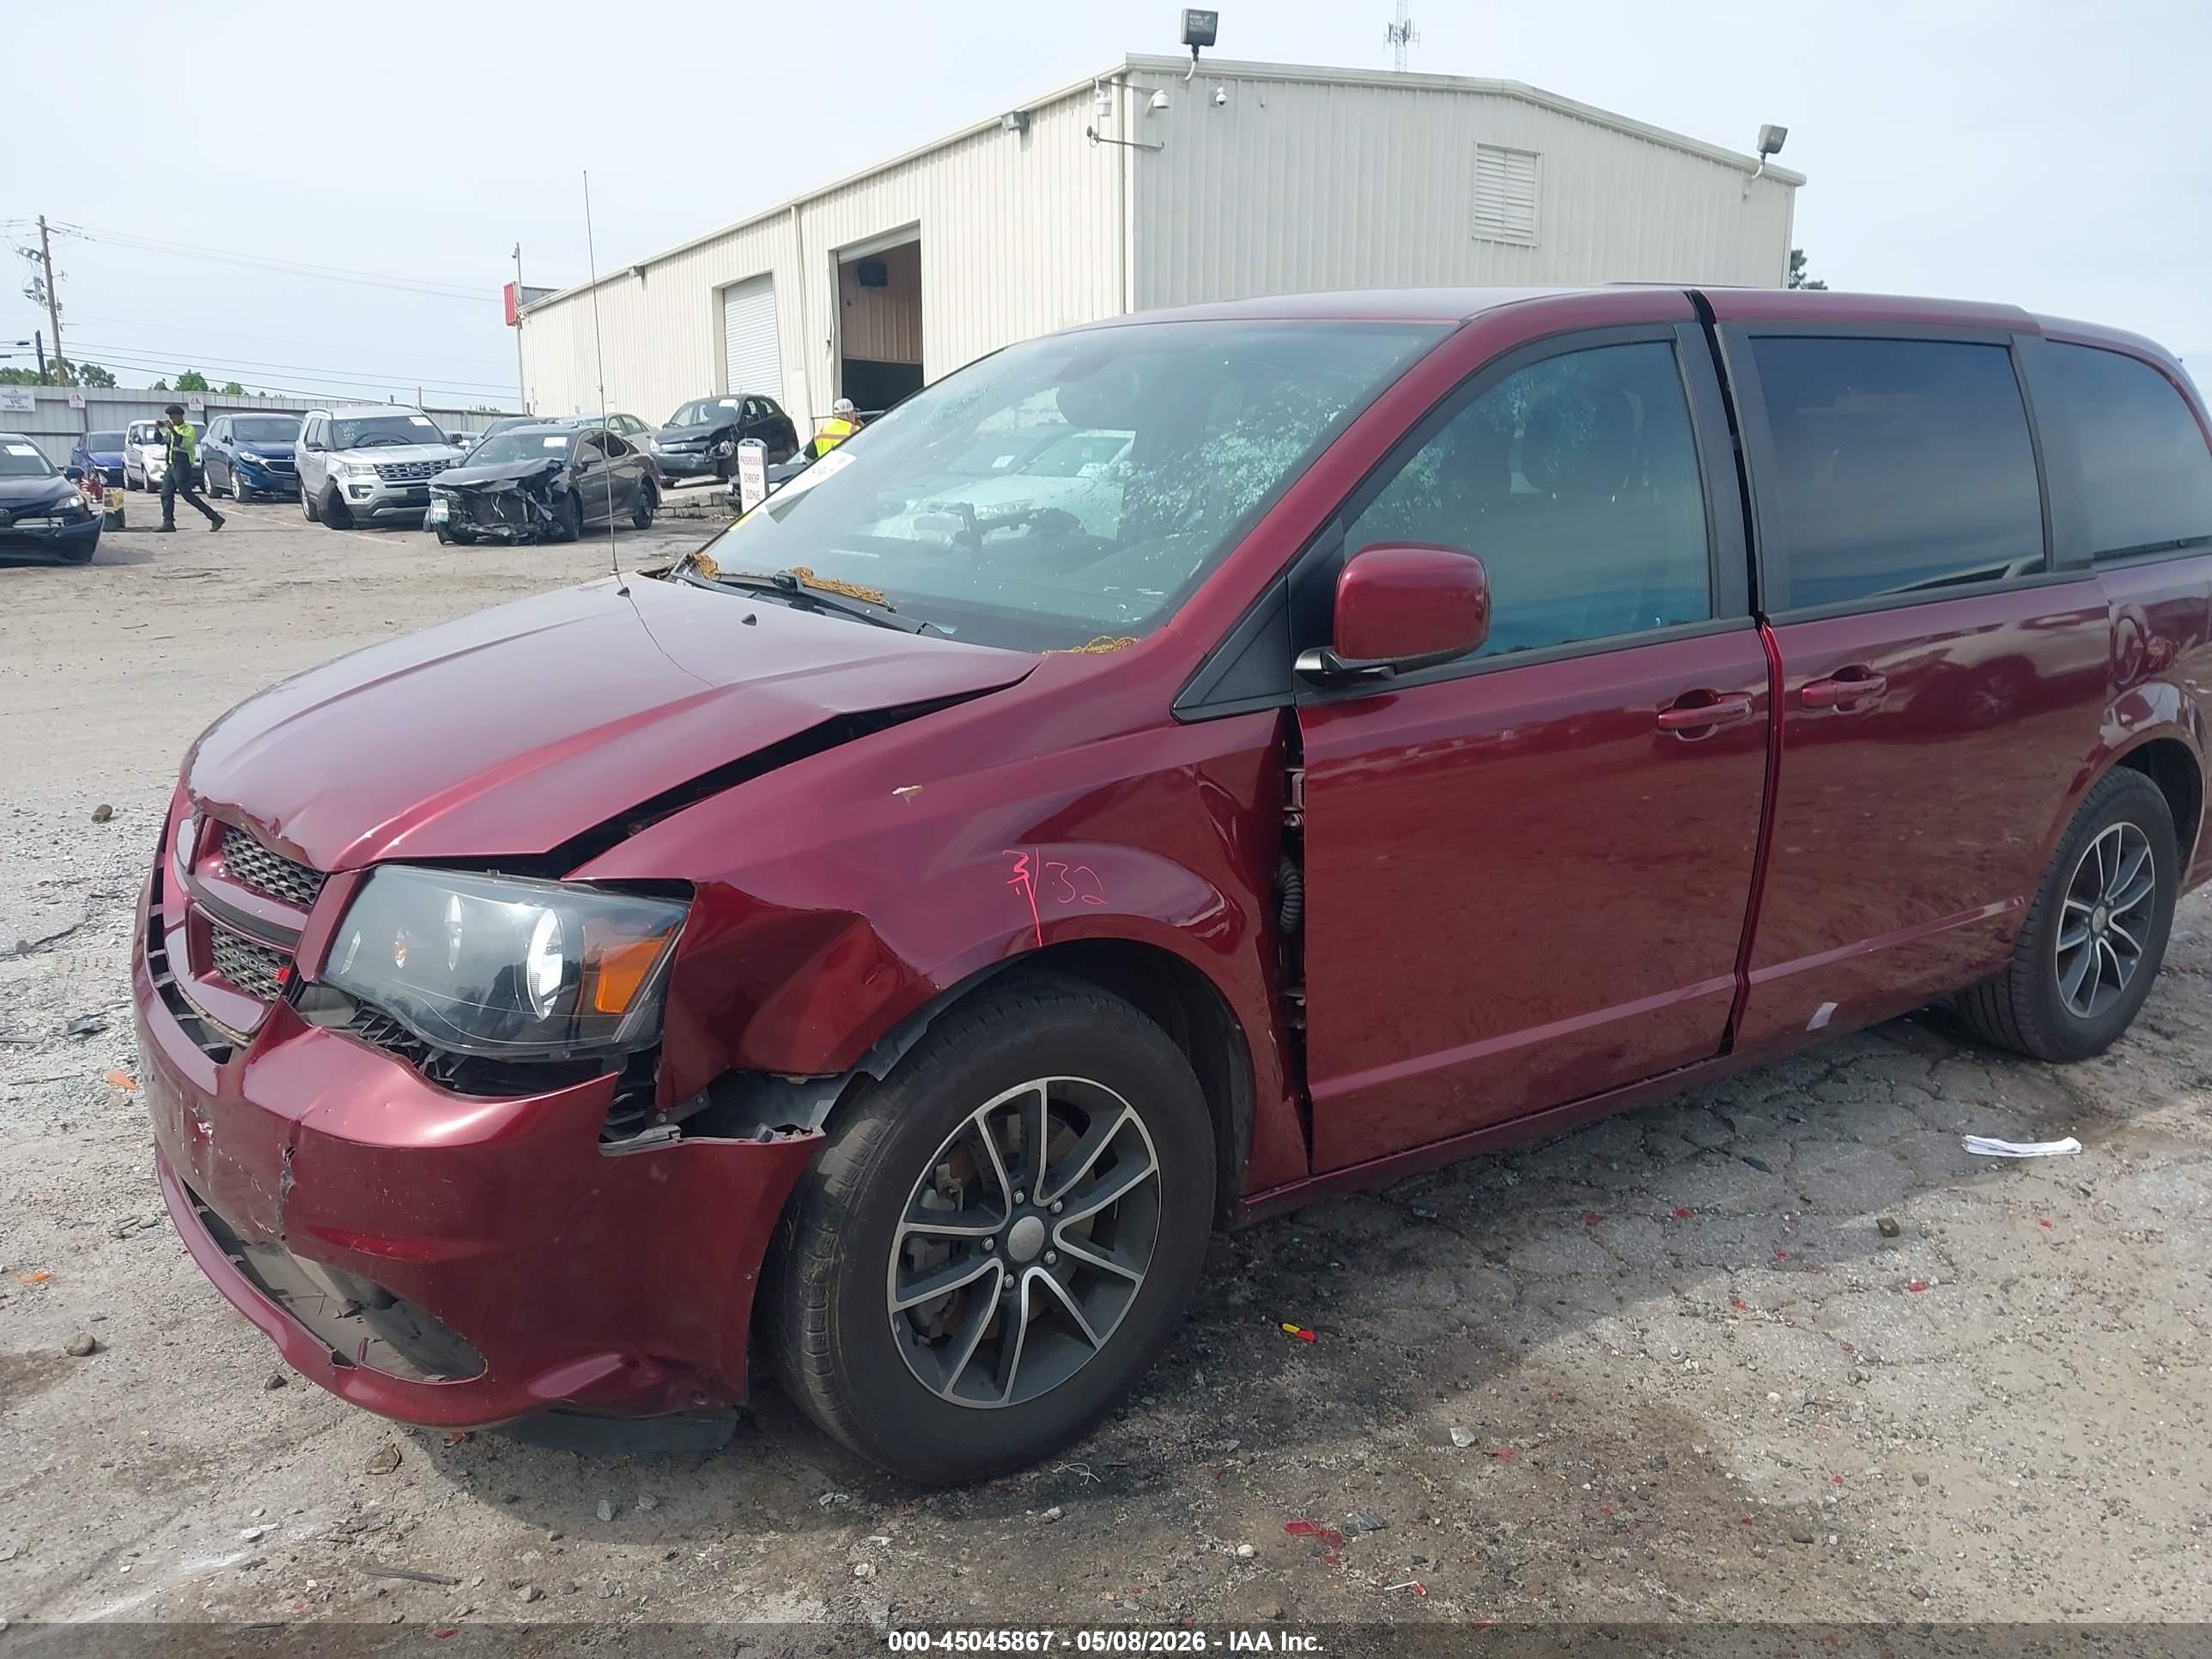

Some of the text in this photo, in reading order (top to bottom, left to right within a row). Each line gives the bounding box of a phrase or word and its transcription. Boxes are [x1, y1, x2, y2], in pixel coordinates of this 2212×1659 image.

[744, 472, 760, 484] DROP
[745, 489, 762, 501] ZONE
[231, 948, 280, 978] DODGE
